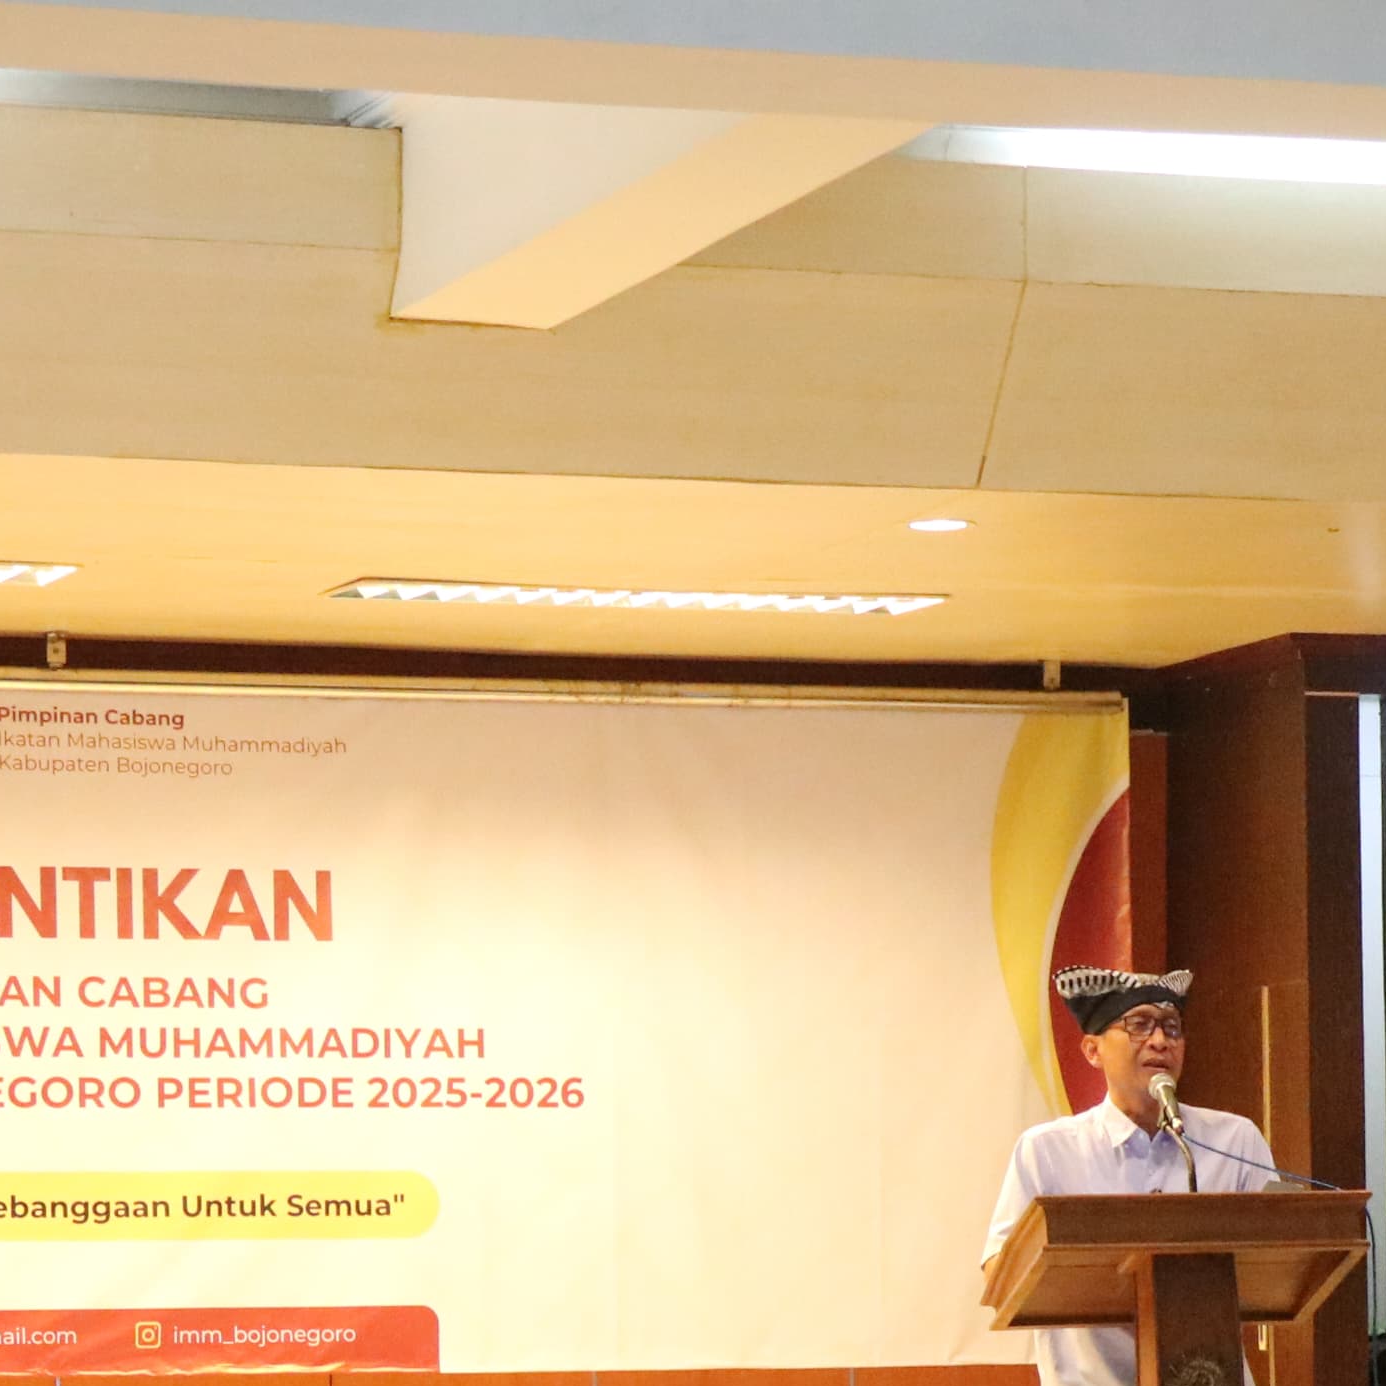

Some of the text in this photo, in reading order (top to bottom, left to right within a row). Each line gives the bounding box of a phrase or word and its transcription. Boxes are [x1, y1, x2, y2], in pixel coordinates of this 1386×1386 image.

[104, 708, 185, 730] Cabang
[67, 732, 176, 751] Mahasiswa
[182, 735, 347, 757] Muhammadiyah
[116, 756, 233, 778] Bojonegoro
[77, 975, 268, 1010] CABANG
[99, 1026, 486, 1059] MUHAMMADIYAH
[157, 1076, 354, 1109] PERIODE
[367, 1076, 585, 1109] 2025-2026
[181, 1193, 277, 1218] Untuk
[286, 1193, 405, 1217] Semua"
[173, 1325, 357, 1348] imm_bojonegoro
